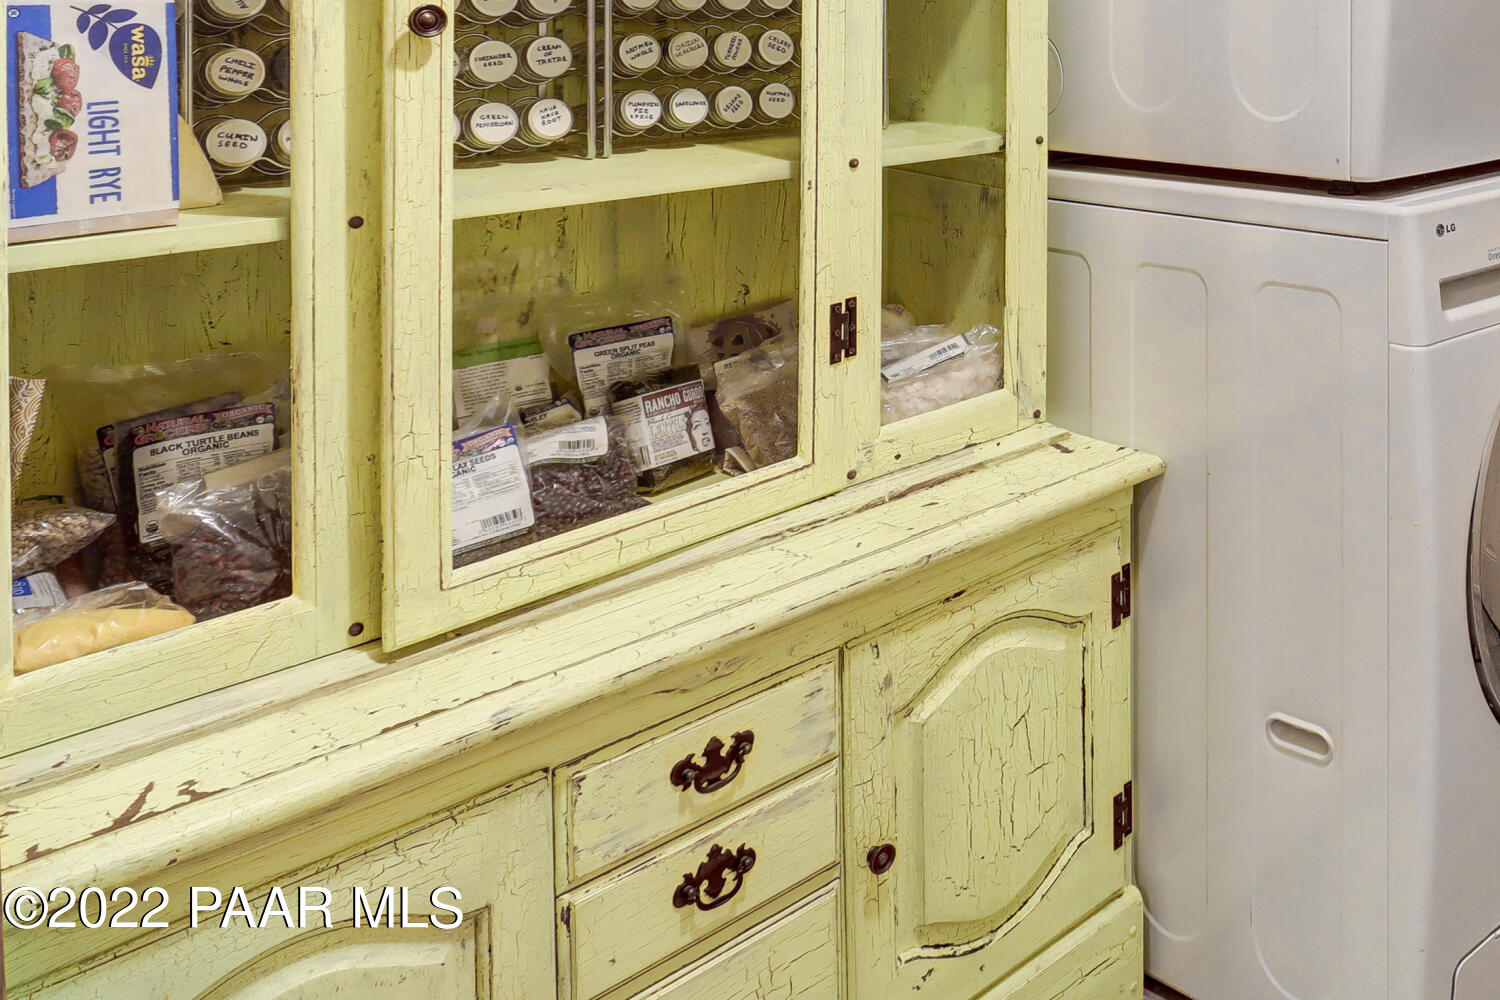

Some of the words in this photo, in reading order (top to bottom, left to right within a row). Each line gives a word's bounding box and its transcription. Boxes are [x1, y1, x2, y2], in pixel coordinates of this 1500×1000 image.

[129, 25, 147, 81] wasa
[537, 44, 563, 52] CREAM
[767, 42, 787, 54] SEED
[225, 57, 257, 70] CHILI
[219, 65, 256, 81] PEPPER
[218, 75, 249, 87] WHOLE
[479, 113, 510, 121] GREEN
[87, 100, 121, 156] LIGHT
[217, 132, 259, 142] CUMIN
[217, 140, 248, 150] SEED
[88, 167, 122, 204] RYE
[1446, 224, 1456, 233] LG
[593, 347, 618, 358] GREEN
[638, 340, 656, 349] PEAS
[644, 392, 682, 414] RANCHO
[682, 386, 705, 403] GORDO
[149, 440, 184, 457] BLACK
[185, 434, 226, 448] TURTLE
[226, 429, 260, 442] BEANS
[181, 441, 230, 456] ORGANIC
[468, 452, 497, 466] SEEDS
